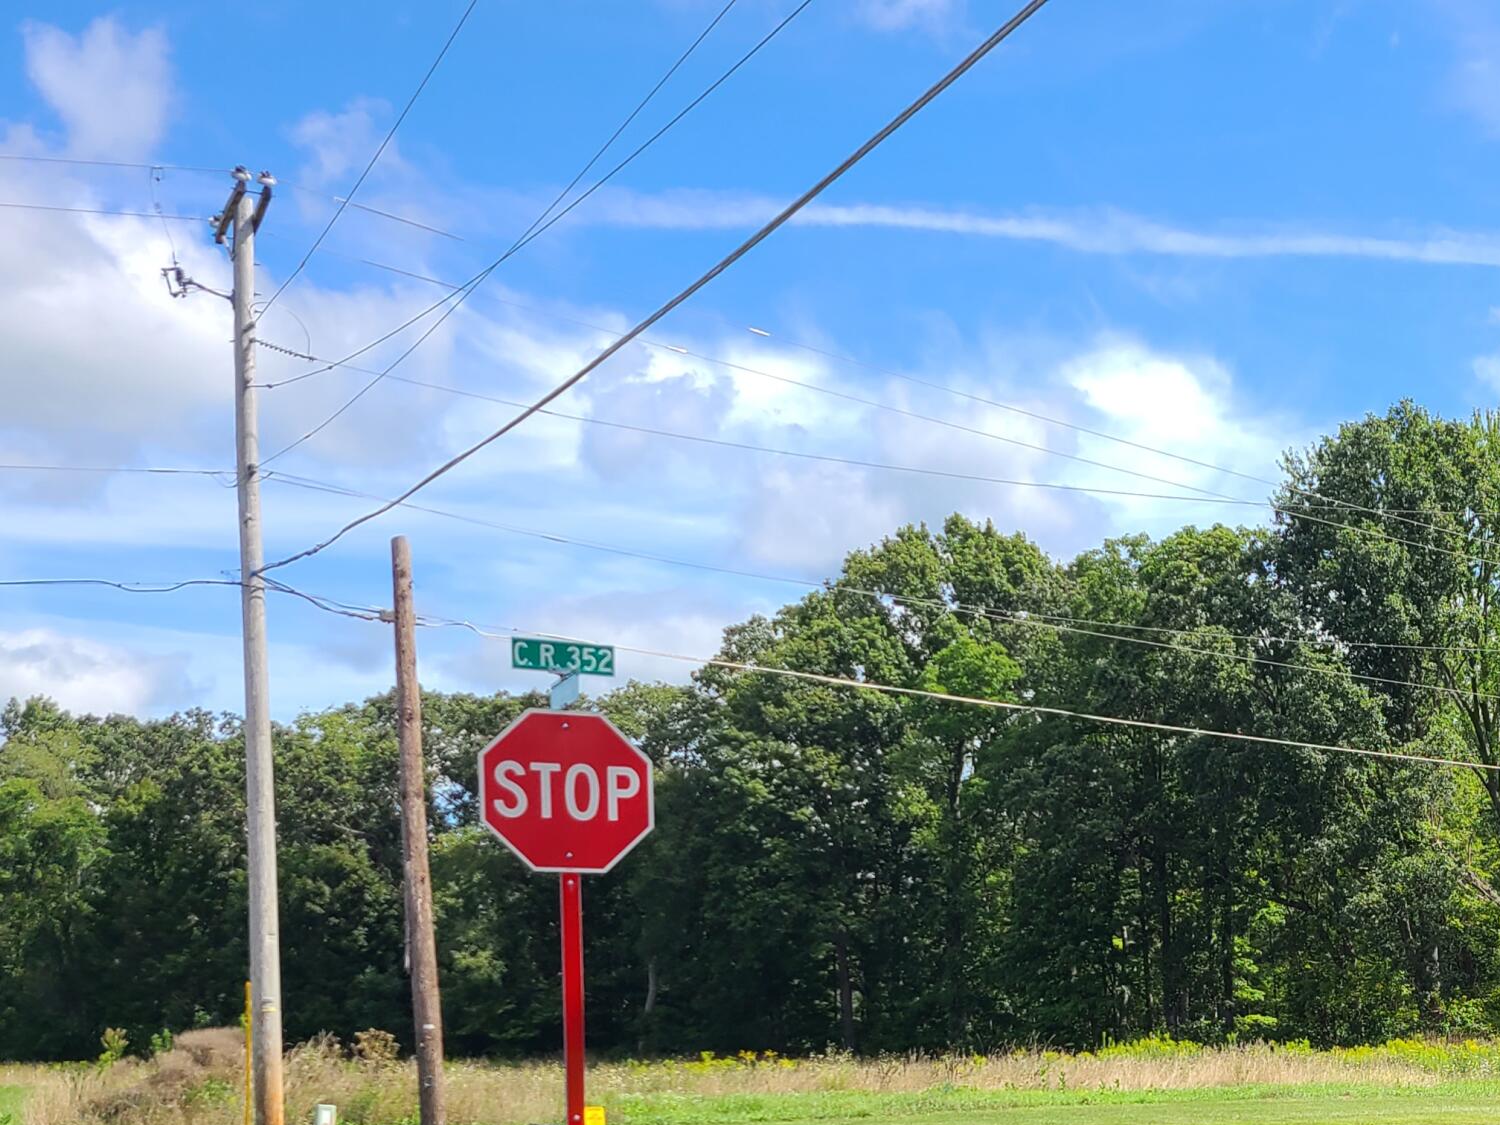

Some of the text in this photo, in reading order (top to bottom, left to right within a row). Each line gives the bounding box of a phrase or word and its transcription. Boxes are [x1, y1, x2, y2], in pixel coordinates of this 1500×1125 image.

[514, 642, 612, 672] C. R. 352
[493, 760, 640, 821] STOP
